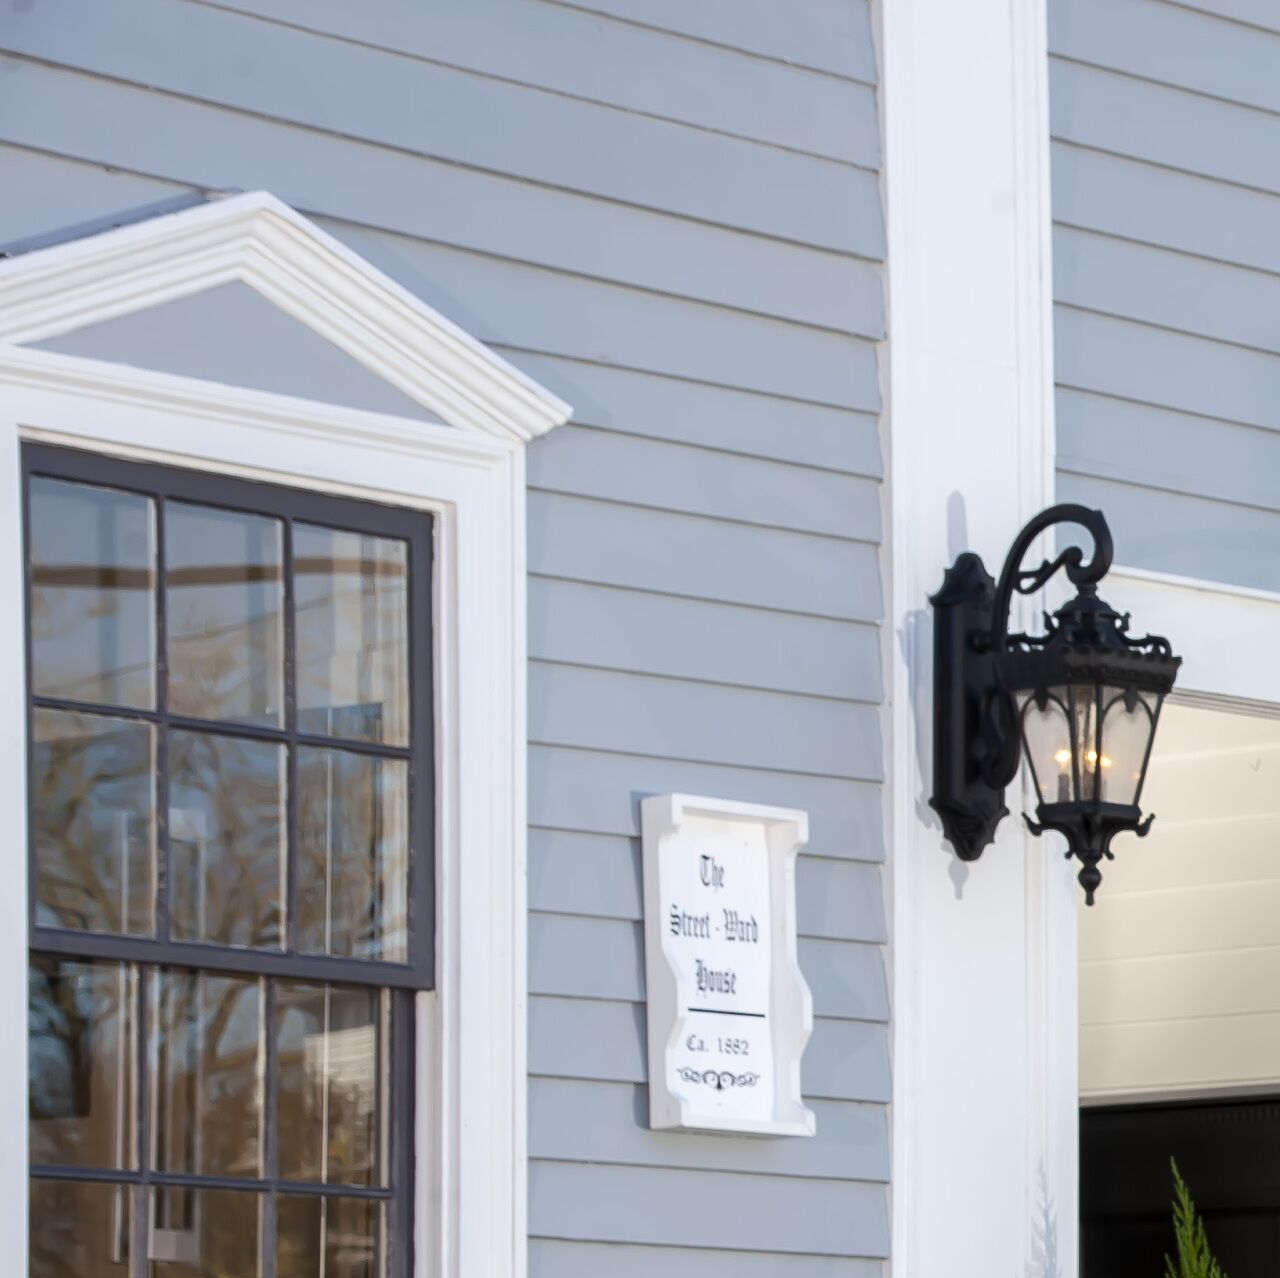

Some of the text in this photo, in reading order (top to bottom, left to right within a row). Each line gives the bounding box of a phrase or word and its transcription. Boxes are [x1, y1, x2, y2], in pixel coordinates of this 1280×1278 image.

[700, 854, 725, 891] The
[669, 904, 711, 941] Street
[722, 908, 759, 943] Ward
[695, 959, 737, 995] House
[686, 1034, 749, 1056] Ca. 1882
